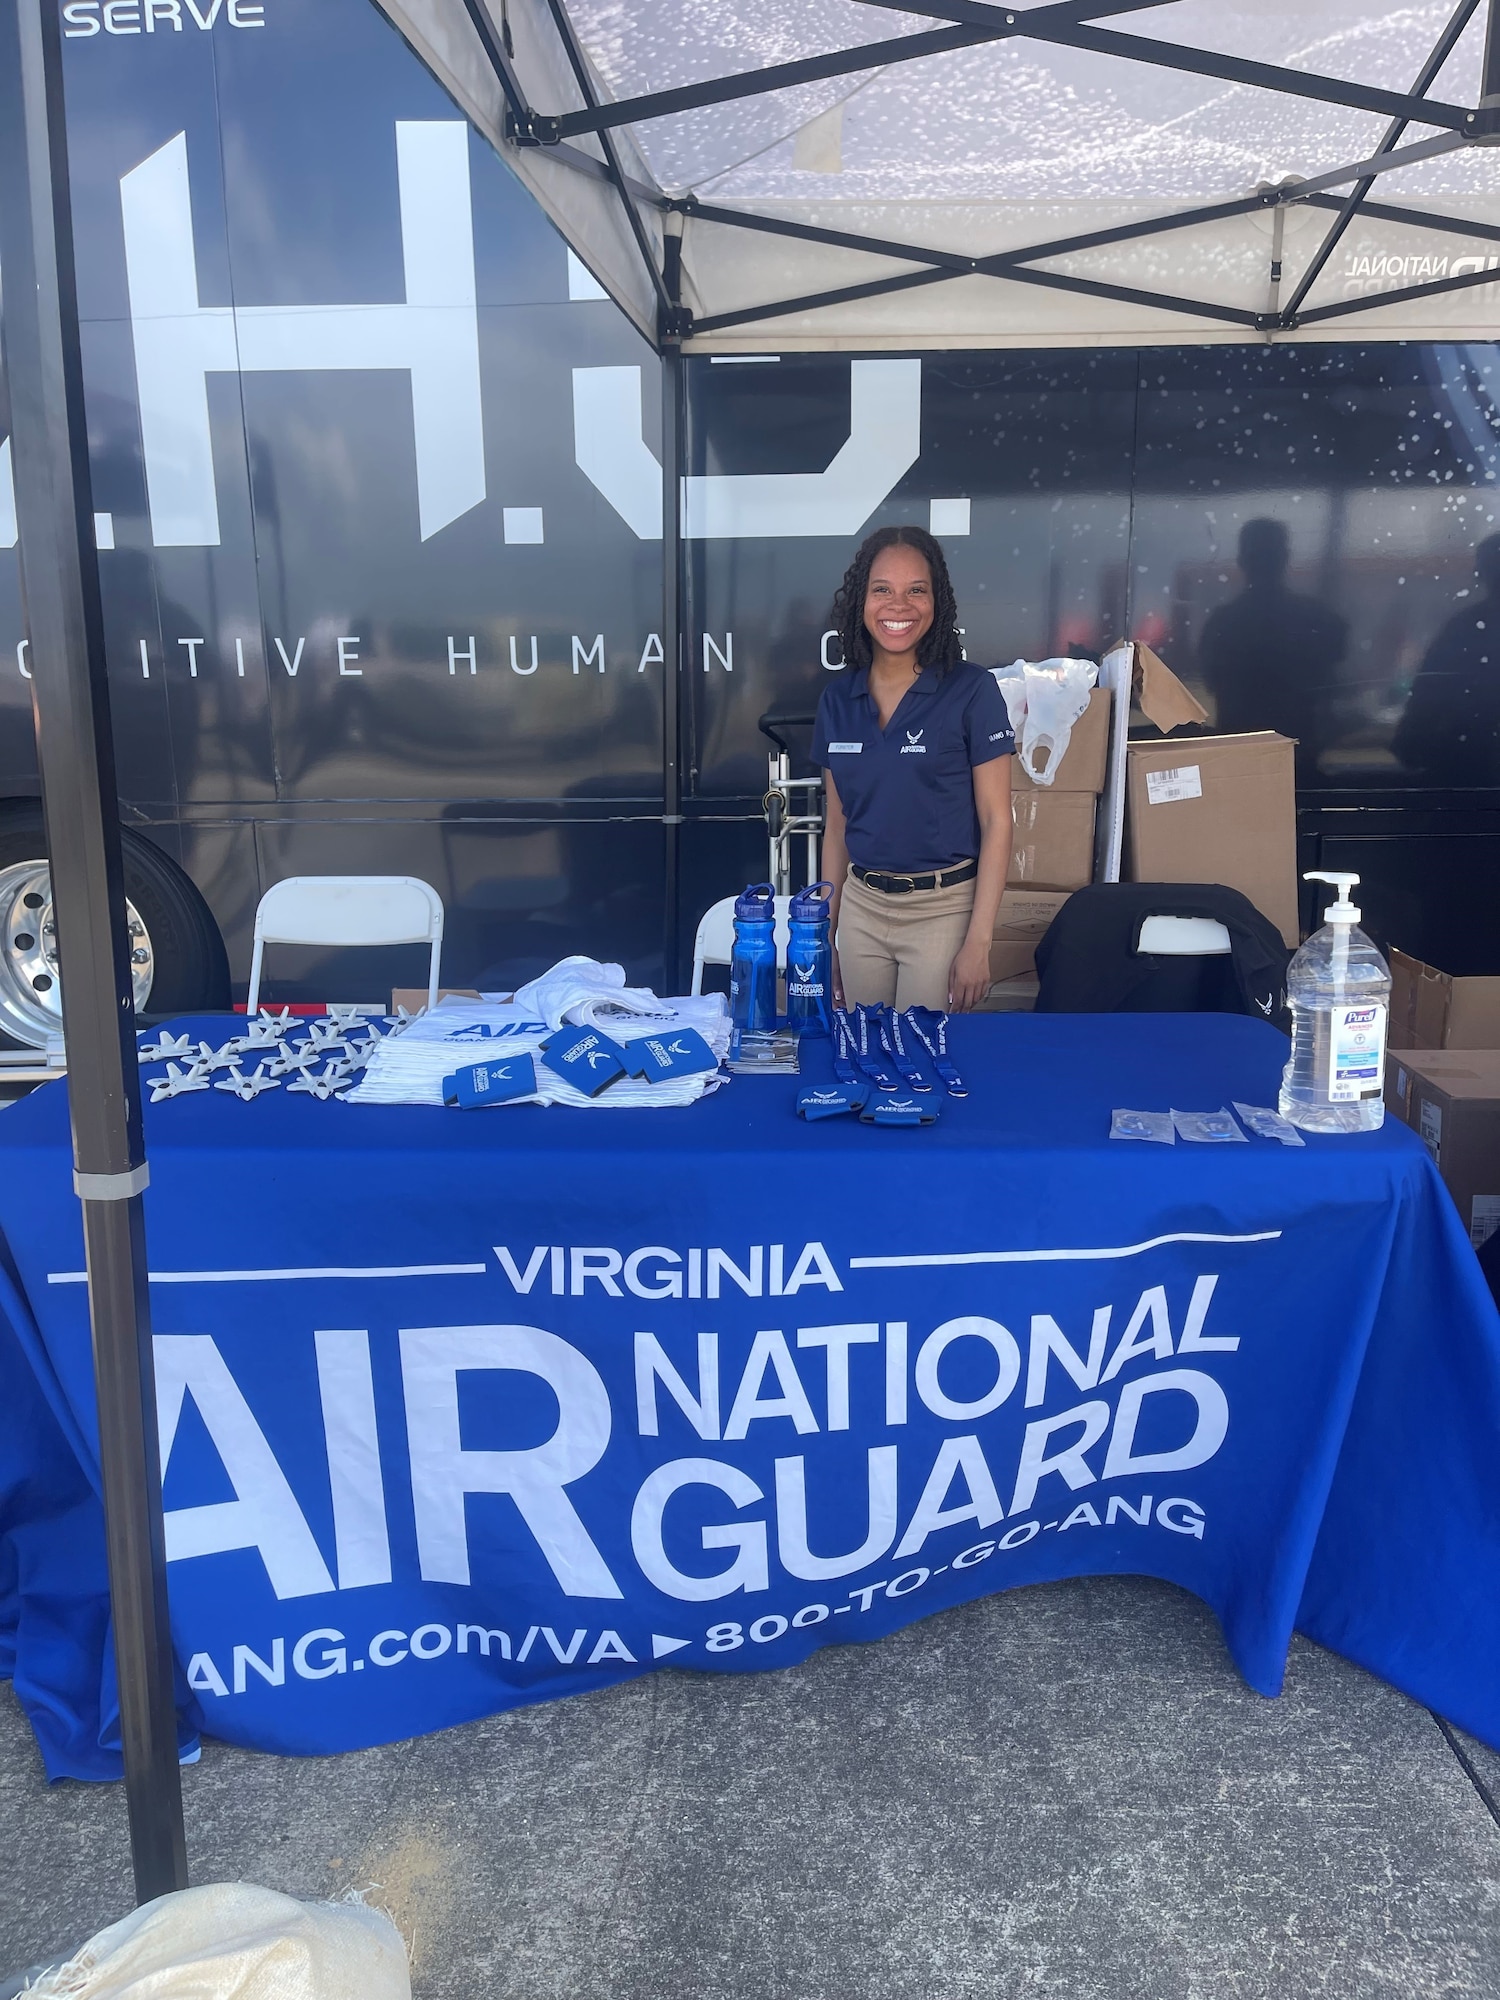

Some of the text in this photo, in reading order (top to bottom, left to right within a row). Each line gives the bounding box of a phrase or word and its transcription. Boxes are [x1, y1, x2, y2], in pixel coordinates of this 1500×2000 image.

[62, 0, 265, 38] SERVE
[447, 632, 733, 676] HUMAN
[789, 982, 803, 995] AIR
[1347, 1010, 1375, 1022] Purell
[444, 1022, 550, 1038] AIR
[582, 1034, 600, 1050] AIR
[646, 1040, 664, 1052] AIR
[563, 1043, 586, 1063] GUARD
[475, 1067, 488, 1077] AIR
[800, 1097, 822, 1105] AIR
[492, 1241, 843, 1300] VIRGINIA
[633, 1274, 1241, 1441] NATIONAL
[152, 1324, 625, 1602] AIR
[630, 1368, 1229, 1602] GUARD
[186, 1495, 1207, 1697] ANG.com/VA 800-TO-GO-ANG
